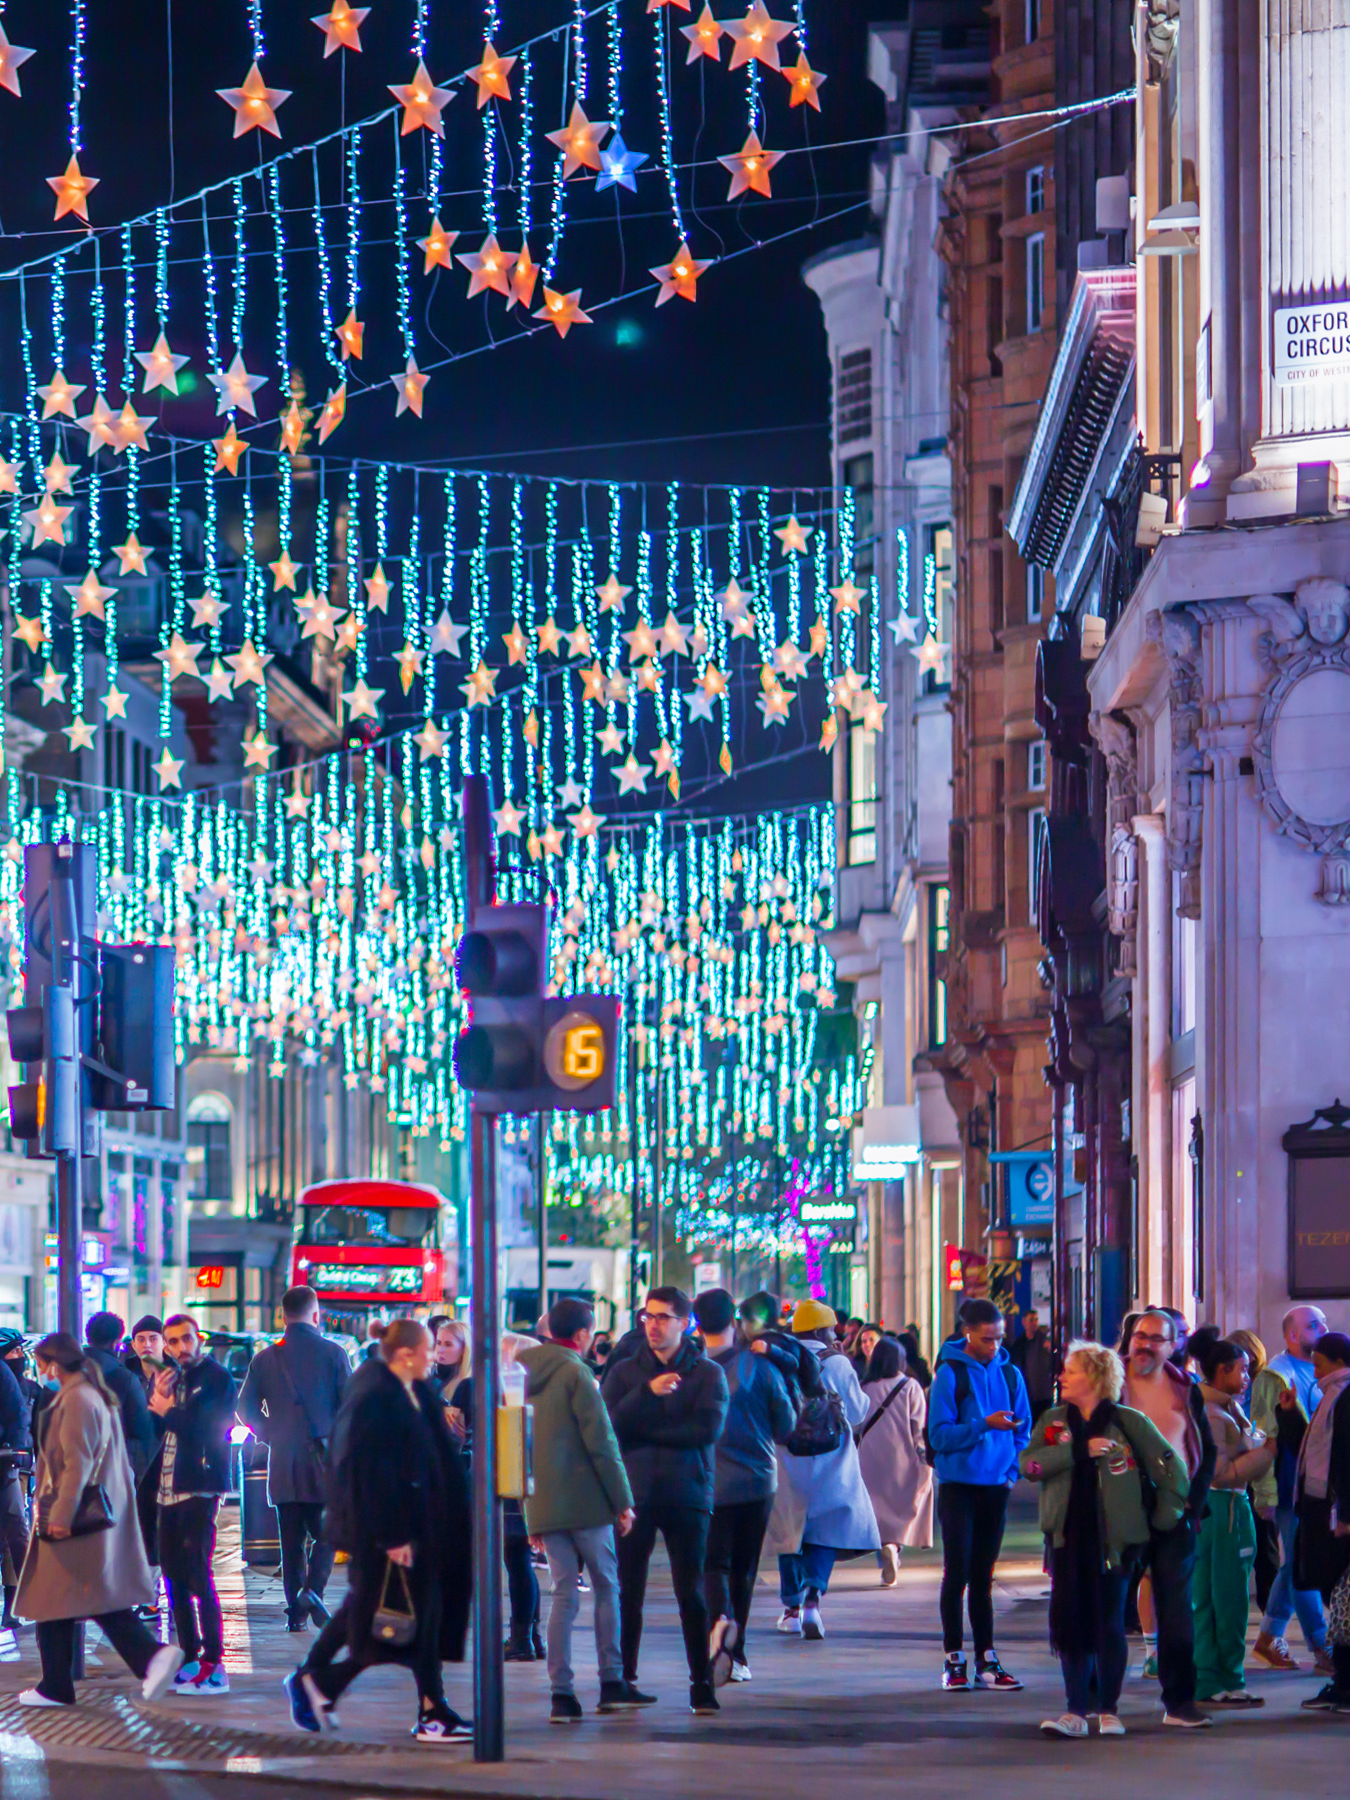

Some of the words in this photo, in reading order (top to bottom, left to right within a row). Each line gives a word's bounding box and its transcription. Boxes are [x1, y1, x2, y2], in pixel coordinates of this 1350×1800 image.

[1287, 311, 1348, 335] OXFOR
[1287, 370, 1306, 380] CITY
[1309, 368, 1319, 378] OF
[390, 1267, 417, 1288] 73
